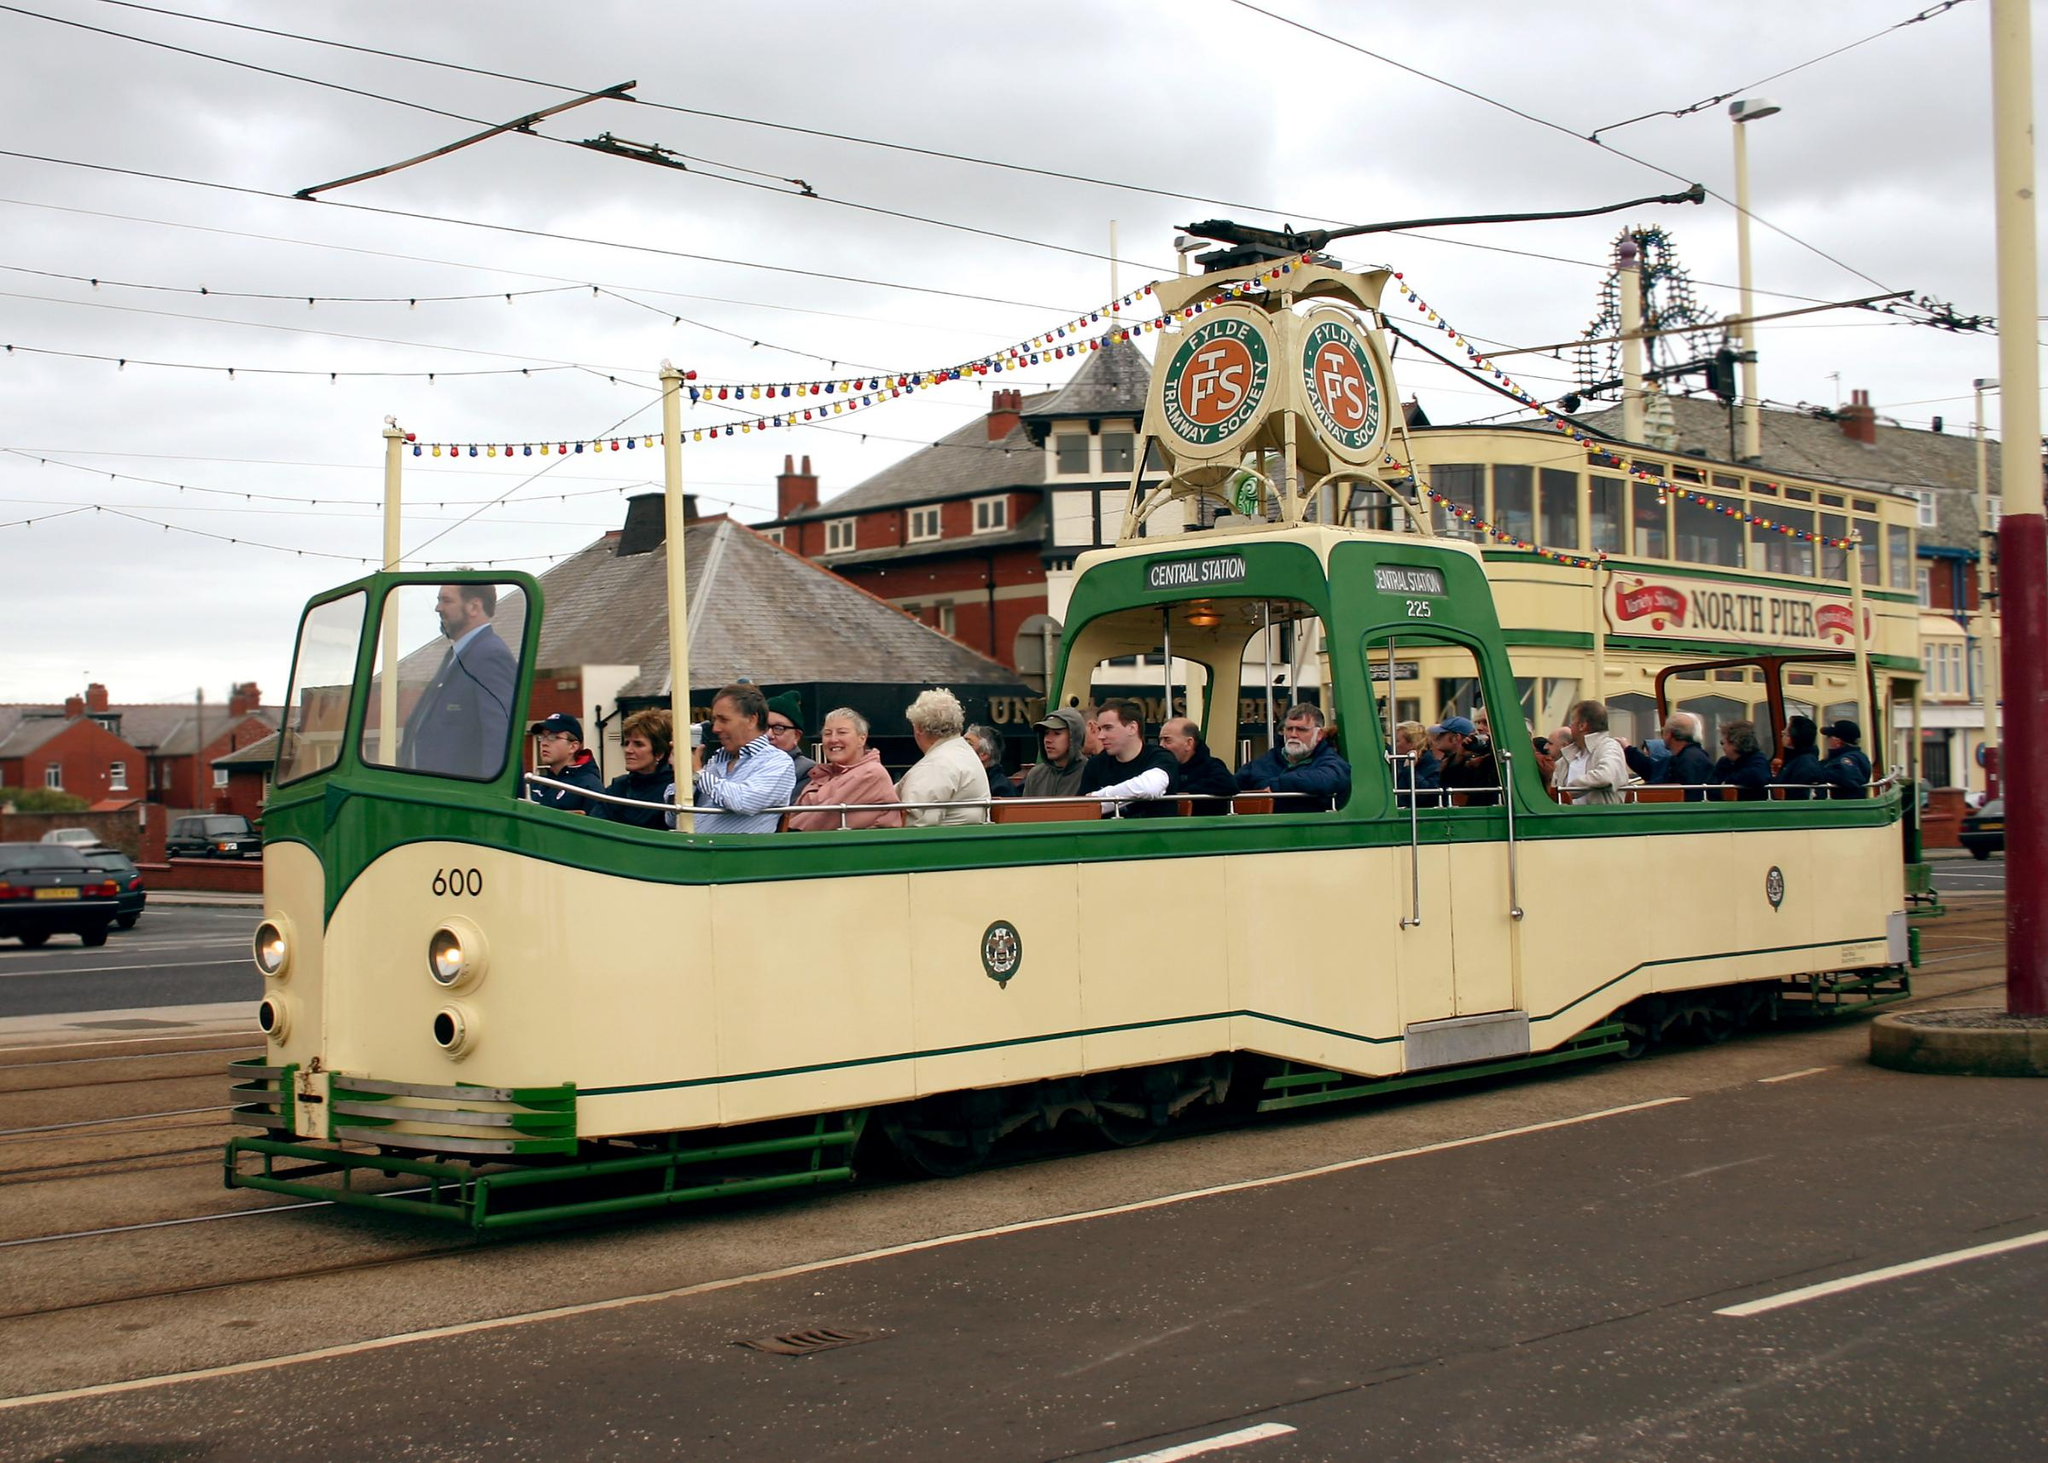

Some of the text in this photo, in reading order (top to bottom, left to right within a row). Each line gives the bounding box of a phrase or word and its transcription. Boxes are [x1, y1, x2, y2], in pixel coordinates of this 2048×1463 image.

[1188, 321, 1250, 350] FYLDE
[1314, 324, 1358, 354] FYLDE
[1165, 361, 1267, 443] TRAMWAY SOCIETY
[1304, 367, 1378, 446] TRAMWAY SOCIETY
[1150, 557, 1246, 587] CENTRAL STATION
[1407, 571, 1441, 593] STATION
[1406, 600, 1431, 617] 225
[1690, 589, 1764, 634] NORTH
[1769, 597, 1816, 638] PIER
[432, 868, 482, 896] 600
